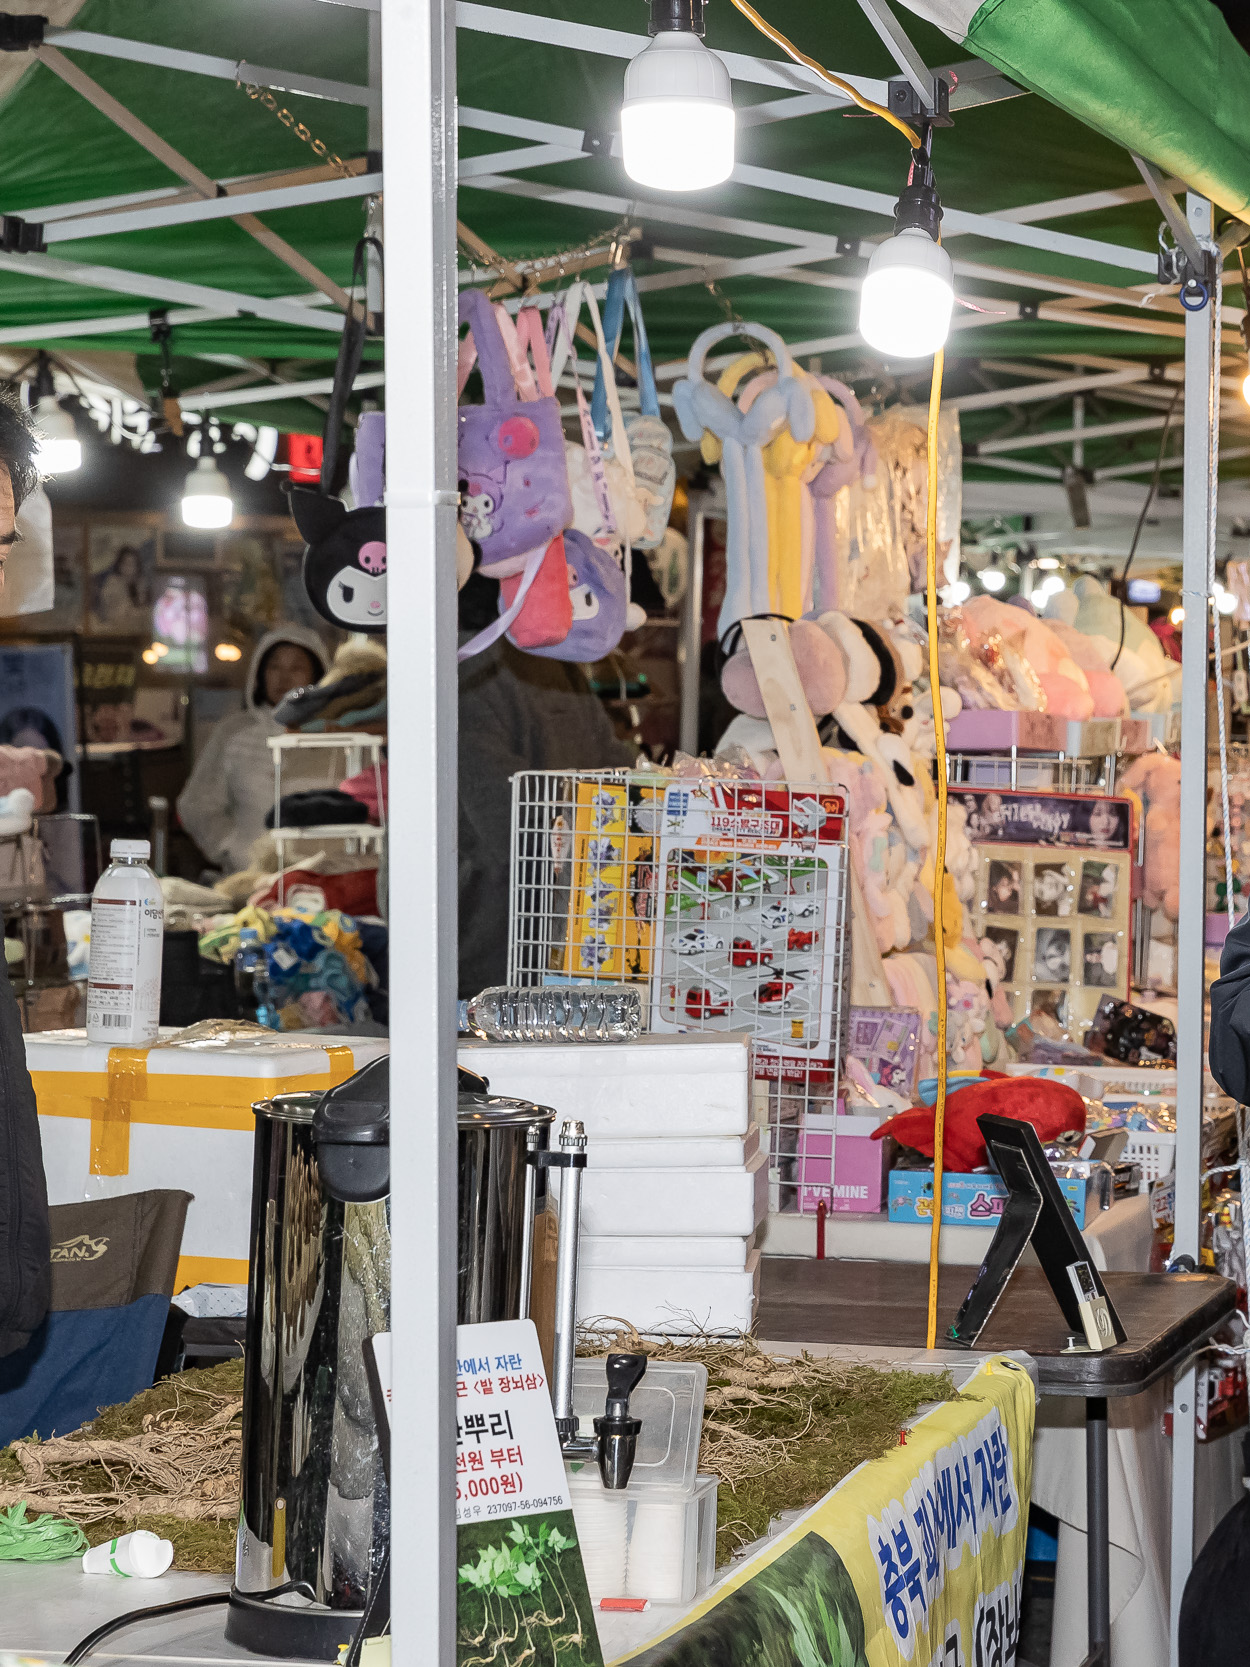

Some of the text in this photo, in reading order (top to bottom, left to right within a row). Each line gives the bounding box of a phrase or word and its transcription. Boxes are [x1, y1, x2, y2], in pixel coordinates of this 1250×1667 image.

[833, 1185, 868, 1199] MINE
[495, 1353, 523, 1372] 자란
[490, 1445, 524, 1469] 부터
[877, 1519, 927, 1639] 충북
[975, 1574, 1022, 1667] (장뇌
